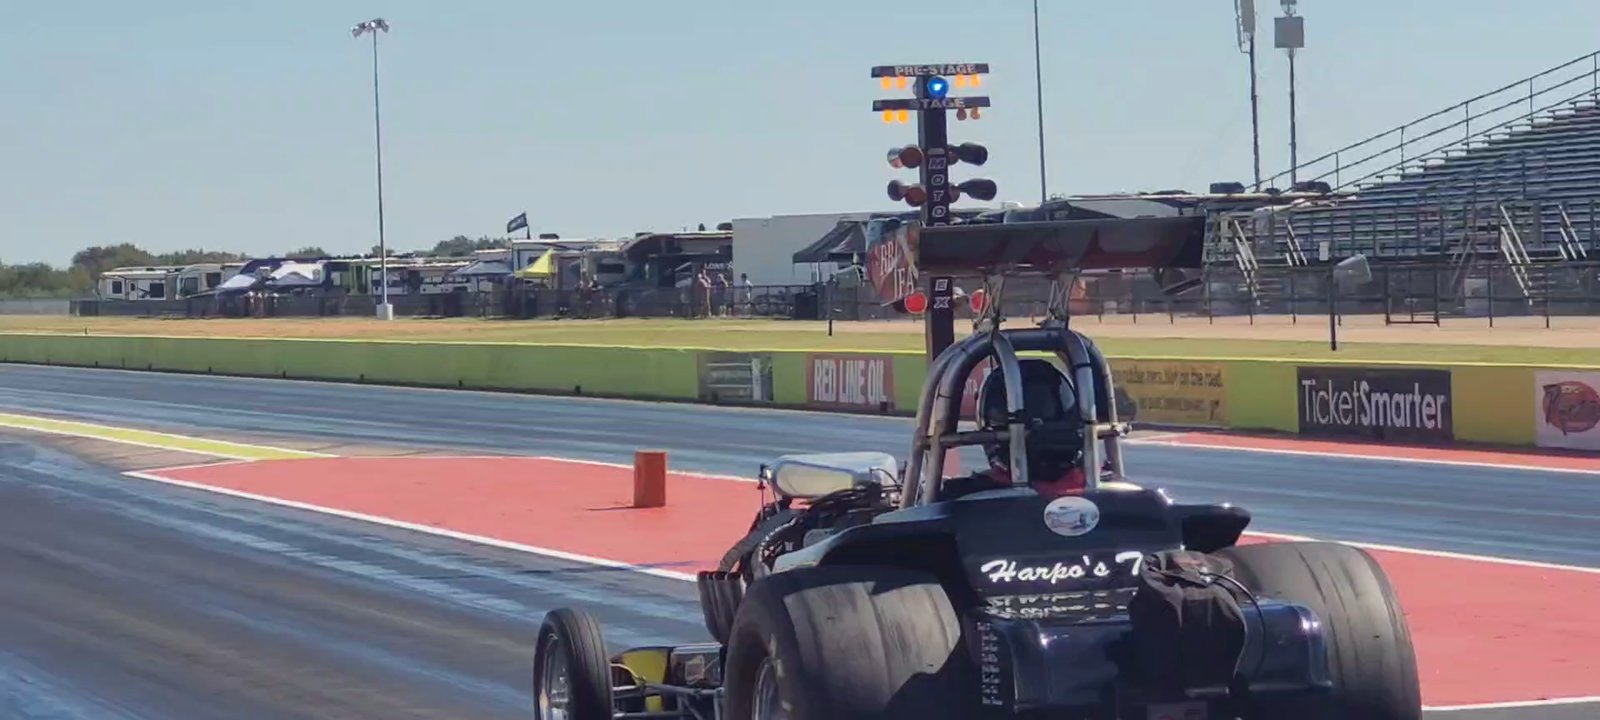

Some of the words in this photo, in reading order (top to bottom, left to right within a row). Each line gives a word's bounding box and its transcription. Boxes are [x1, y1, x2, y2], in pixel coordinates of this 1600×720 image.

[894, 63, 976, 75] PRE-STAGE
[911, 98, 965, 109] STAGE
[813, 359, 837, 401] RED
[839, 359, 865, 403] LINE
[867, 359, 888, 404] OIL
[1301, 379, 1445, 429] TicketSmarter
[981, 555, 1109, 584] Harpo's
